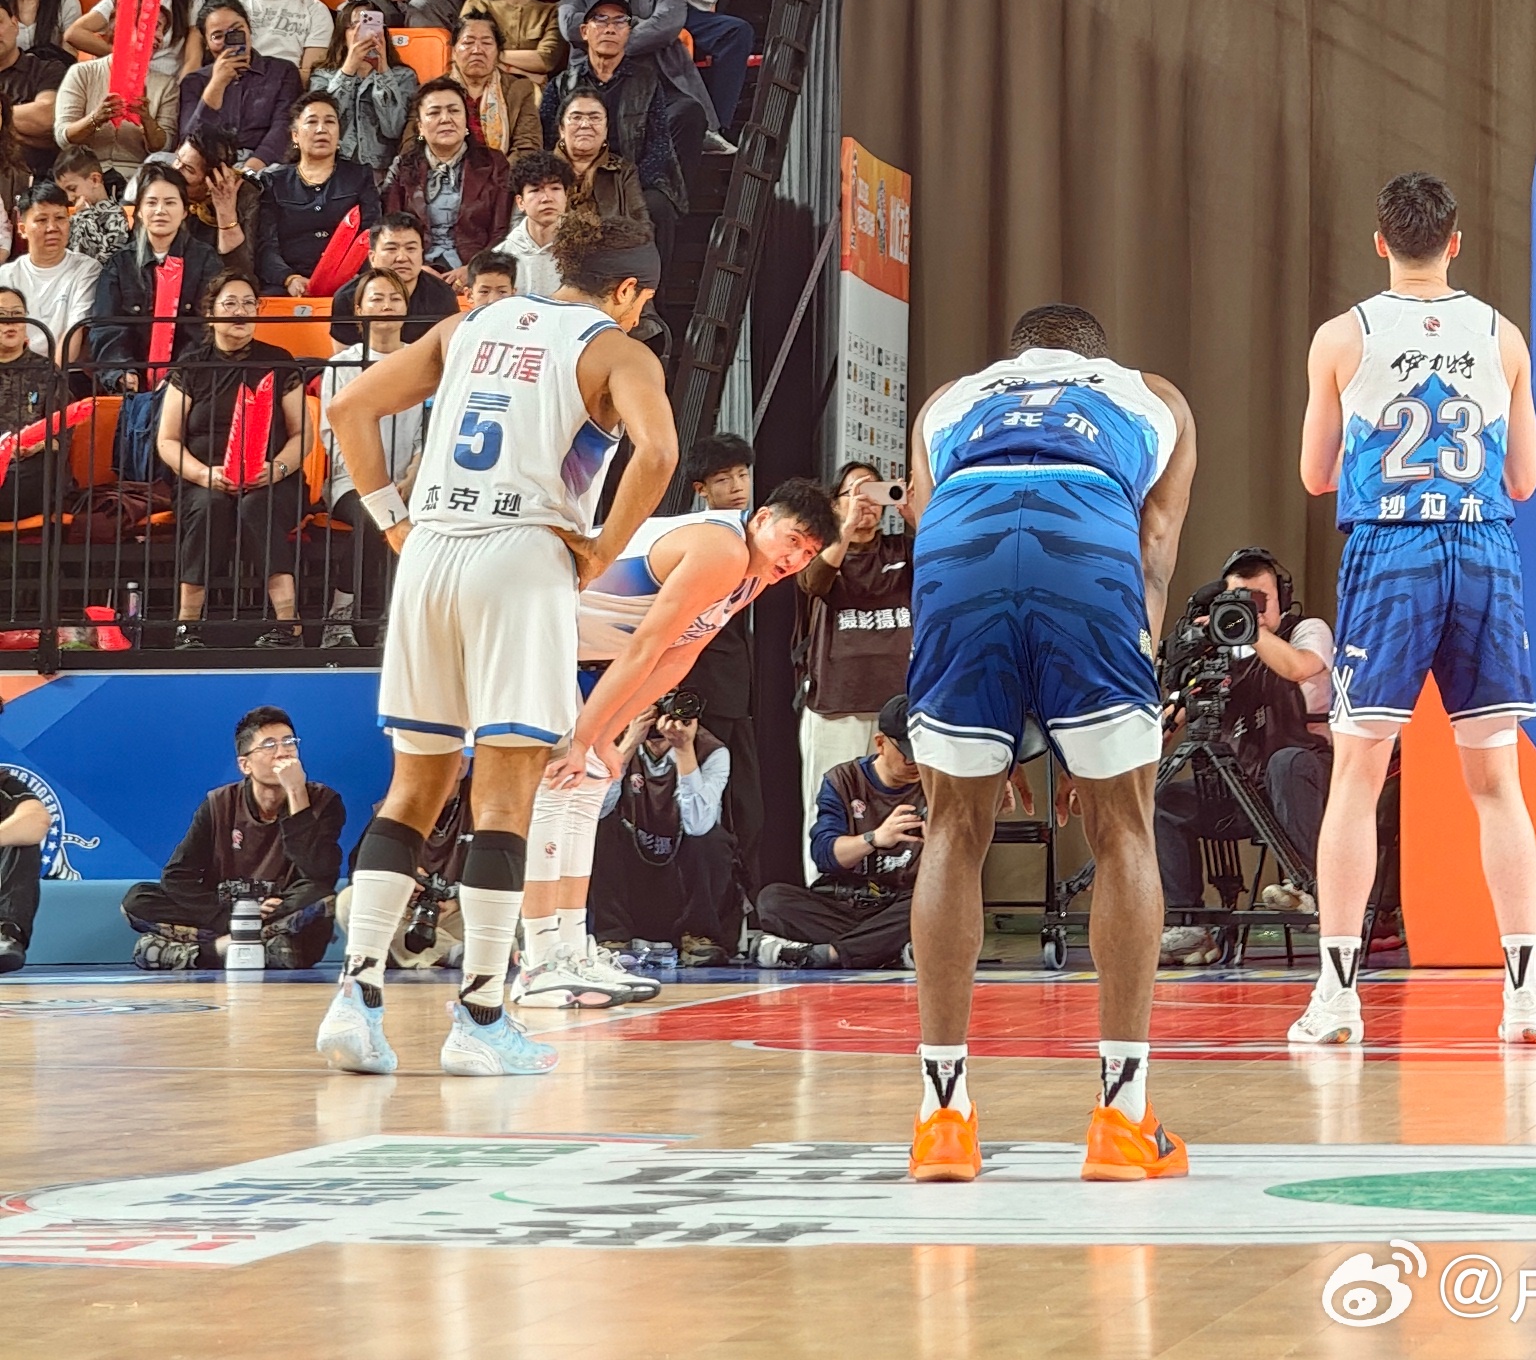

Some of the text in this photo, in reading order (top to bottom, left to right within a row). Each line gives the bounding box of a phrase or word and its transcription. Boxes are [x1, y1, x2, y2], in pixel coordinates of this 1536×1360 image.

[470, 339, 549, 384] 町渥
[1390, 349, 1476, 382] 伊力特
[453, 411, 504, 472] 5
[1378, 396, 1487, 484] 23
[421, 484, 522, 518] 杰克逊
[1377, 491, 1484, 522] 沙拉木
